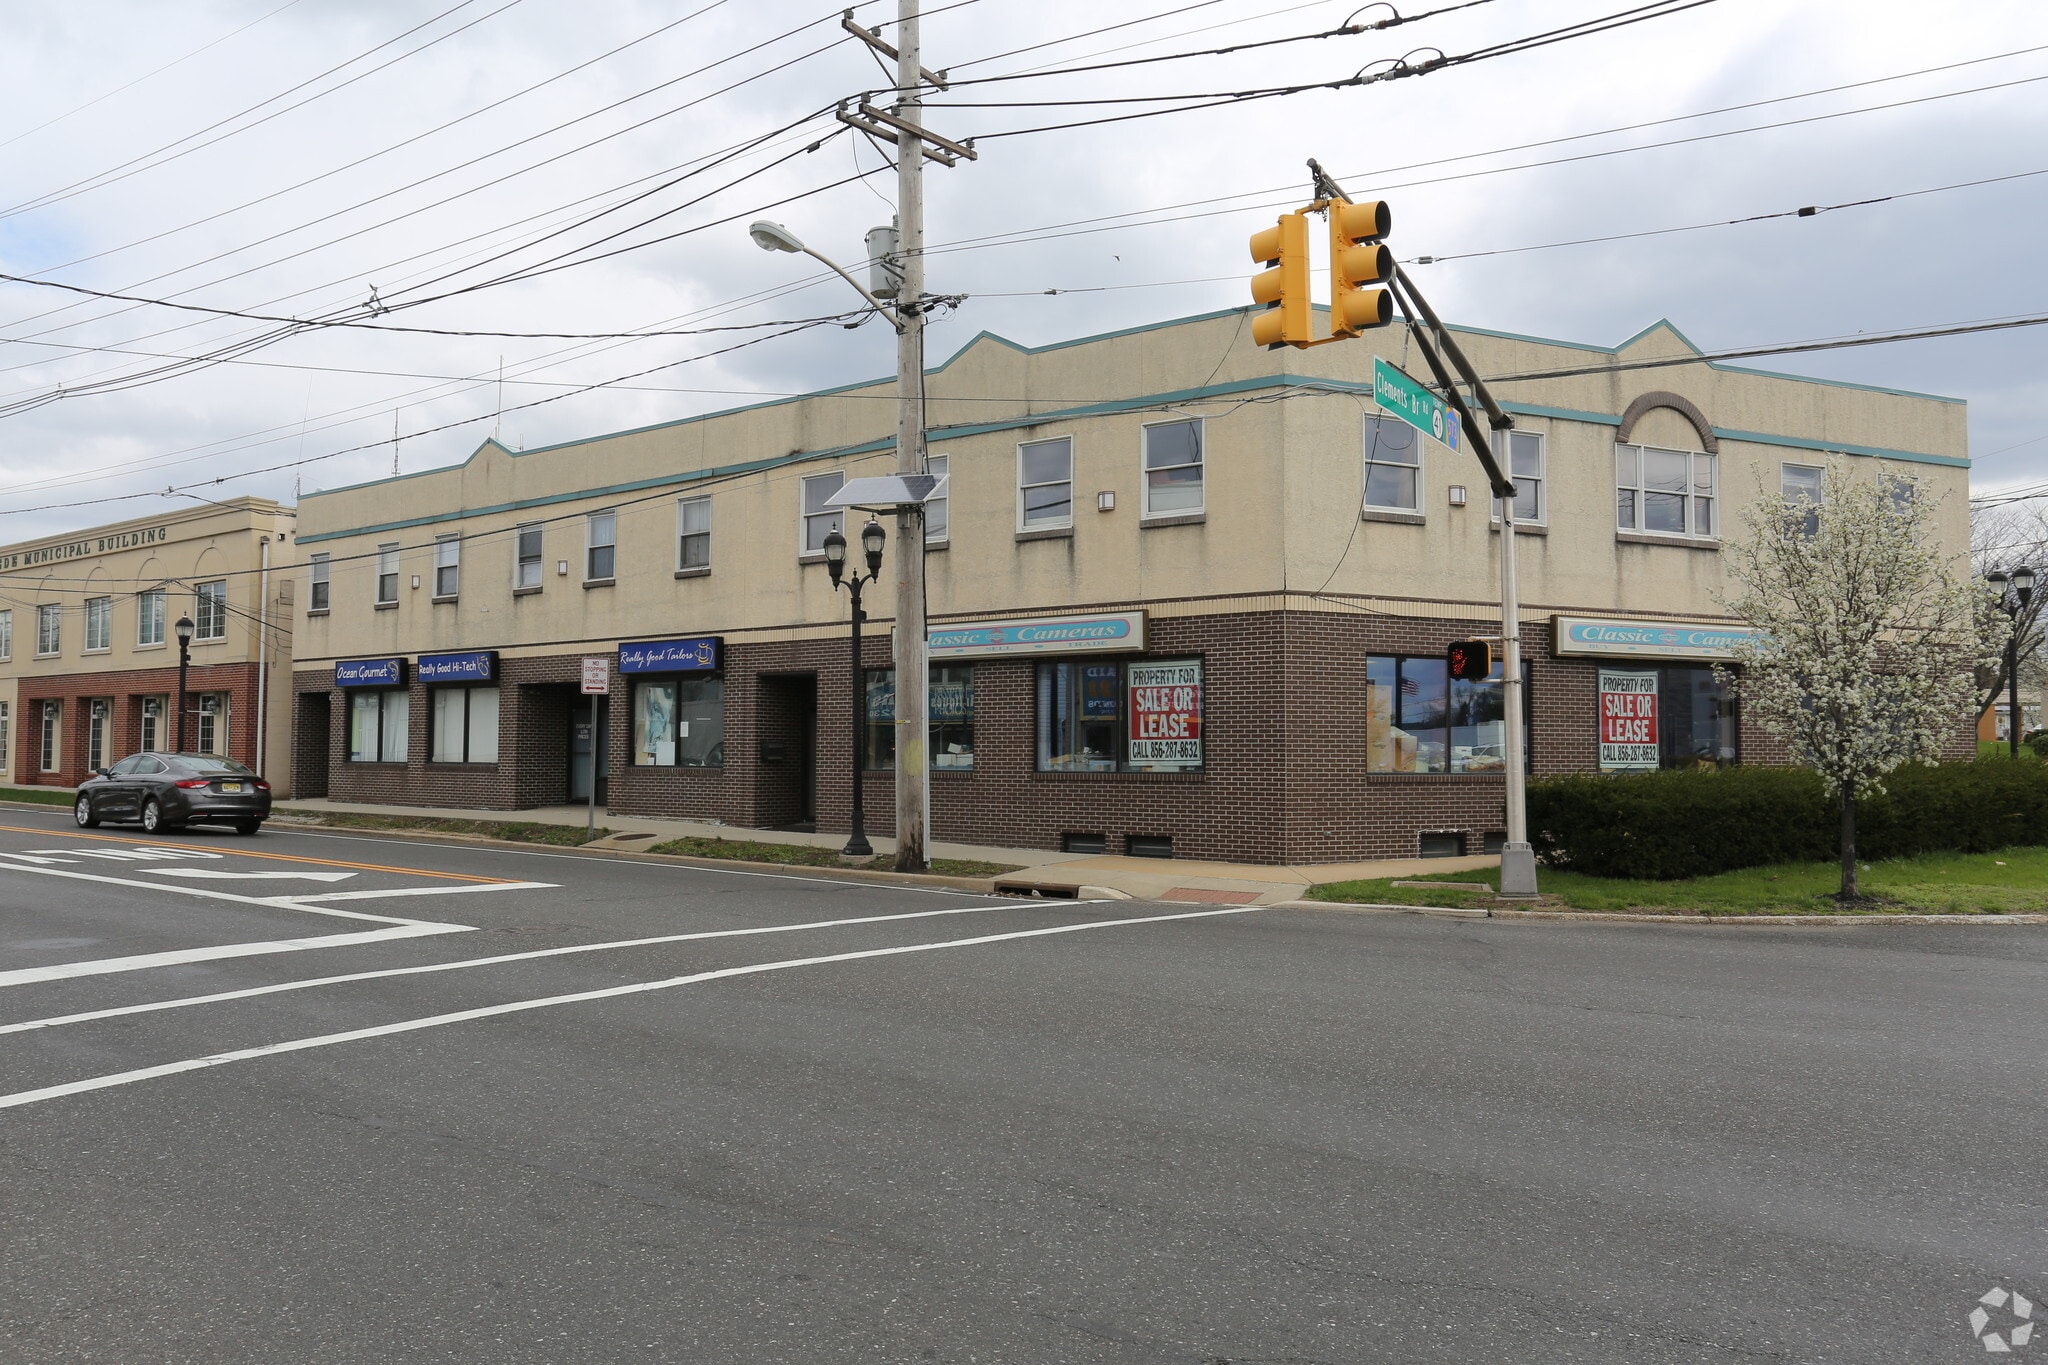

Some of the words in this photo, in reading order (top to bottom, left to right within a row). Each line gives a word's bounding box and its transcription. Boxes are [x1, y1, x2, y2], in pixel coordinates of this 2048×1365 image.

[1377, 371, 1407, 408] Clements
[1411, 394, 1419, 415] Br
[1434, 416, 1442, 432] 41
[24, 542, 90, 566] MUNICIPAL
[98, 527, 167, 552] BUILDING
[928, 631, 980, 647] lassic
[1017, 623, 1116, 642] Cameras
[1068, 640, 1108, 648] TRADE
[1581, 626, 1653, 643] Classic
[620, 651, 645, 668] Really
[646, 649, 664, 666] Good
[666, 647, 694, 661] Tailors
[336, 666, 358, 679] Ocean
[358, 664, 388, 681] Gourmet
[419, 664, 436, 677] Really
[437, 662, 450, 673] Good
[452, 661, 477, 672] Hi-Tech
[1133, 668, 1176, 686] PROPERTY
[1178, 668, 1195, 684] FOR
[1602, 677, 1638, 692] PROPERTY
[1639, 678, 1654, 693] FOR
[1136, 687, 1169, 712] SALE
[1173, 686, 1193, 711] OR
[1605, 694, 1634, 717] SALE
[1636, 695, 1652, 718] OR
[1139, 713, 1189, 738] LEASE
[1608, 719, 1650, 742] LEASE
[1132, 741, 1149, 759] CALL
[1150, 740, 1198, 759] 856-287-8632
[1602, 745, 1617, 761] CALL
[1617, 745, 1656, 761] 856-287-8632
